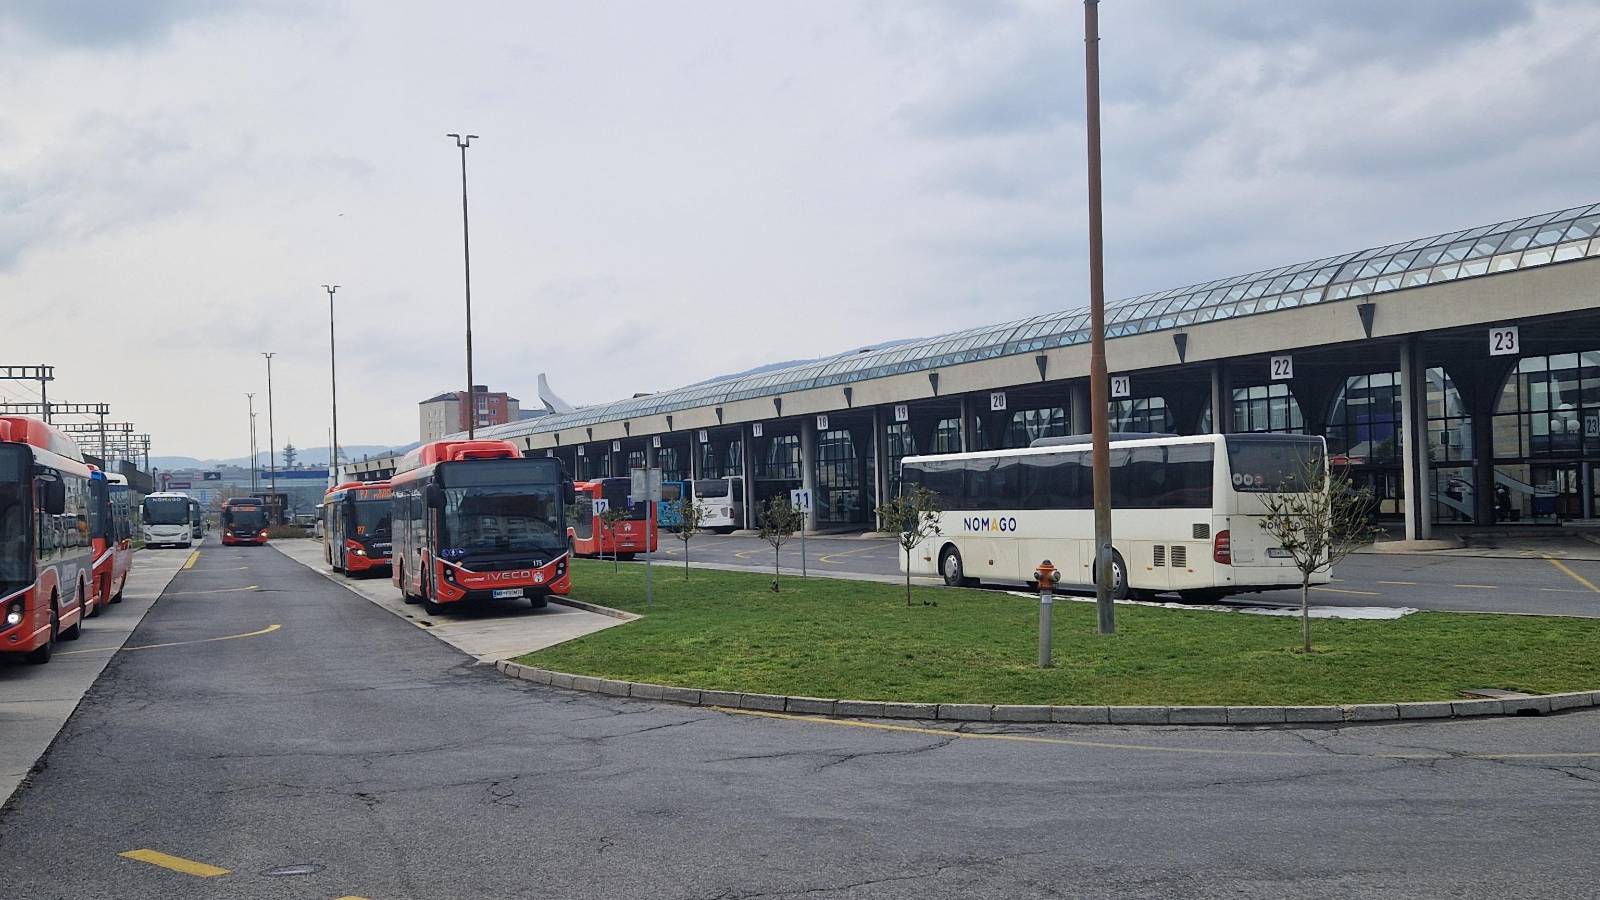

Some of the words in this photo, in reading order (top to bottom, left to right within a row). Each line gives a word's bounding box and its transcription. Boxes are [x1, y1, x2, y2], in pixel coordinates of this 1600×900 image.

[1494, 331, 1514, 351] 23
[1274, 359, 1290, 376] 22
[1114, 379, 1127, 394] 21
[993, 395, 1004, 408] 20
[897, 407, 906, 419] 19
[1586, 419, 1598, 434] 23
[595, 501, 606, 513] 12
[795, 492, 808, 508] 11
[963, 517, 1017, 532] NOMAGO
[487, 572, 530, 580] IVECO
